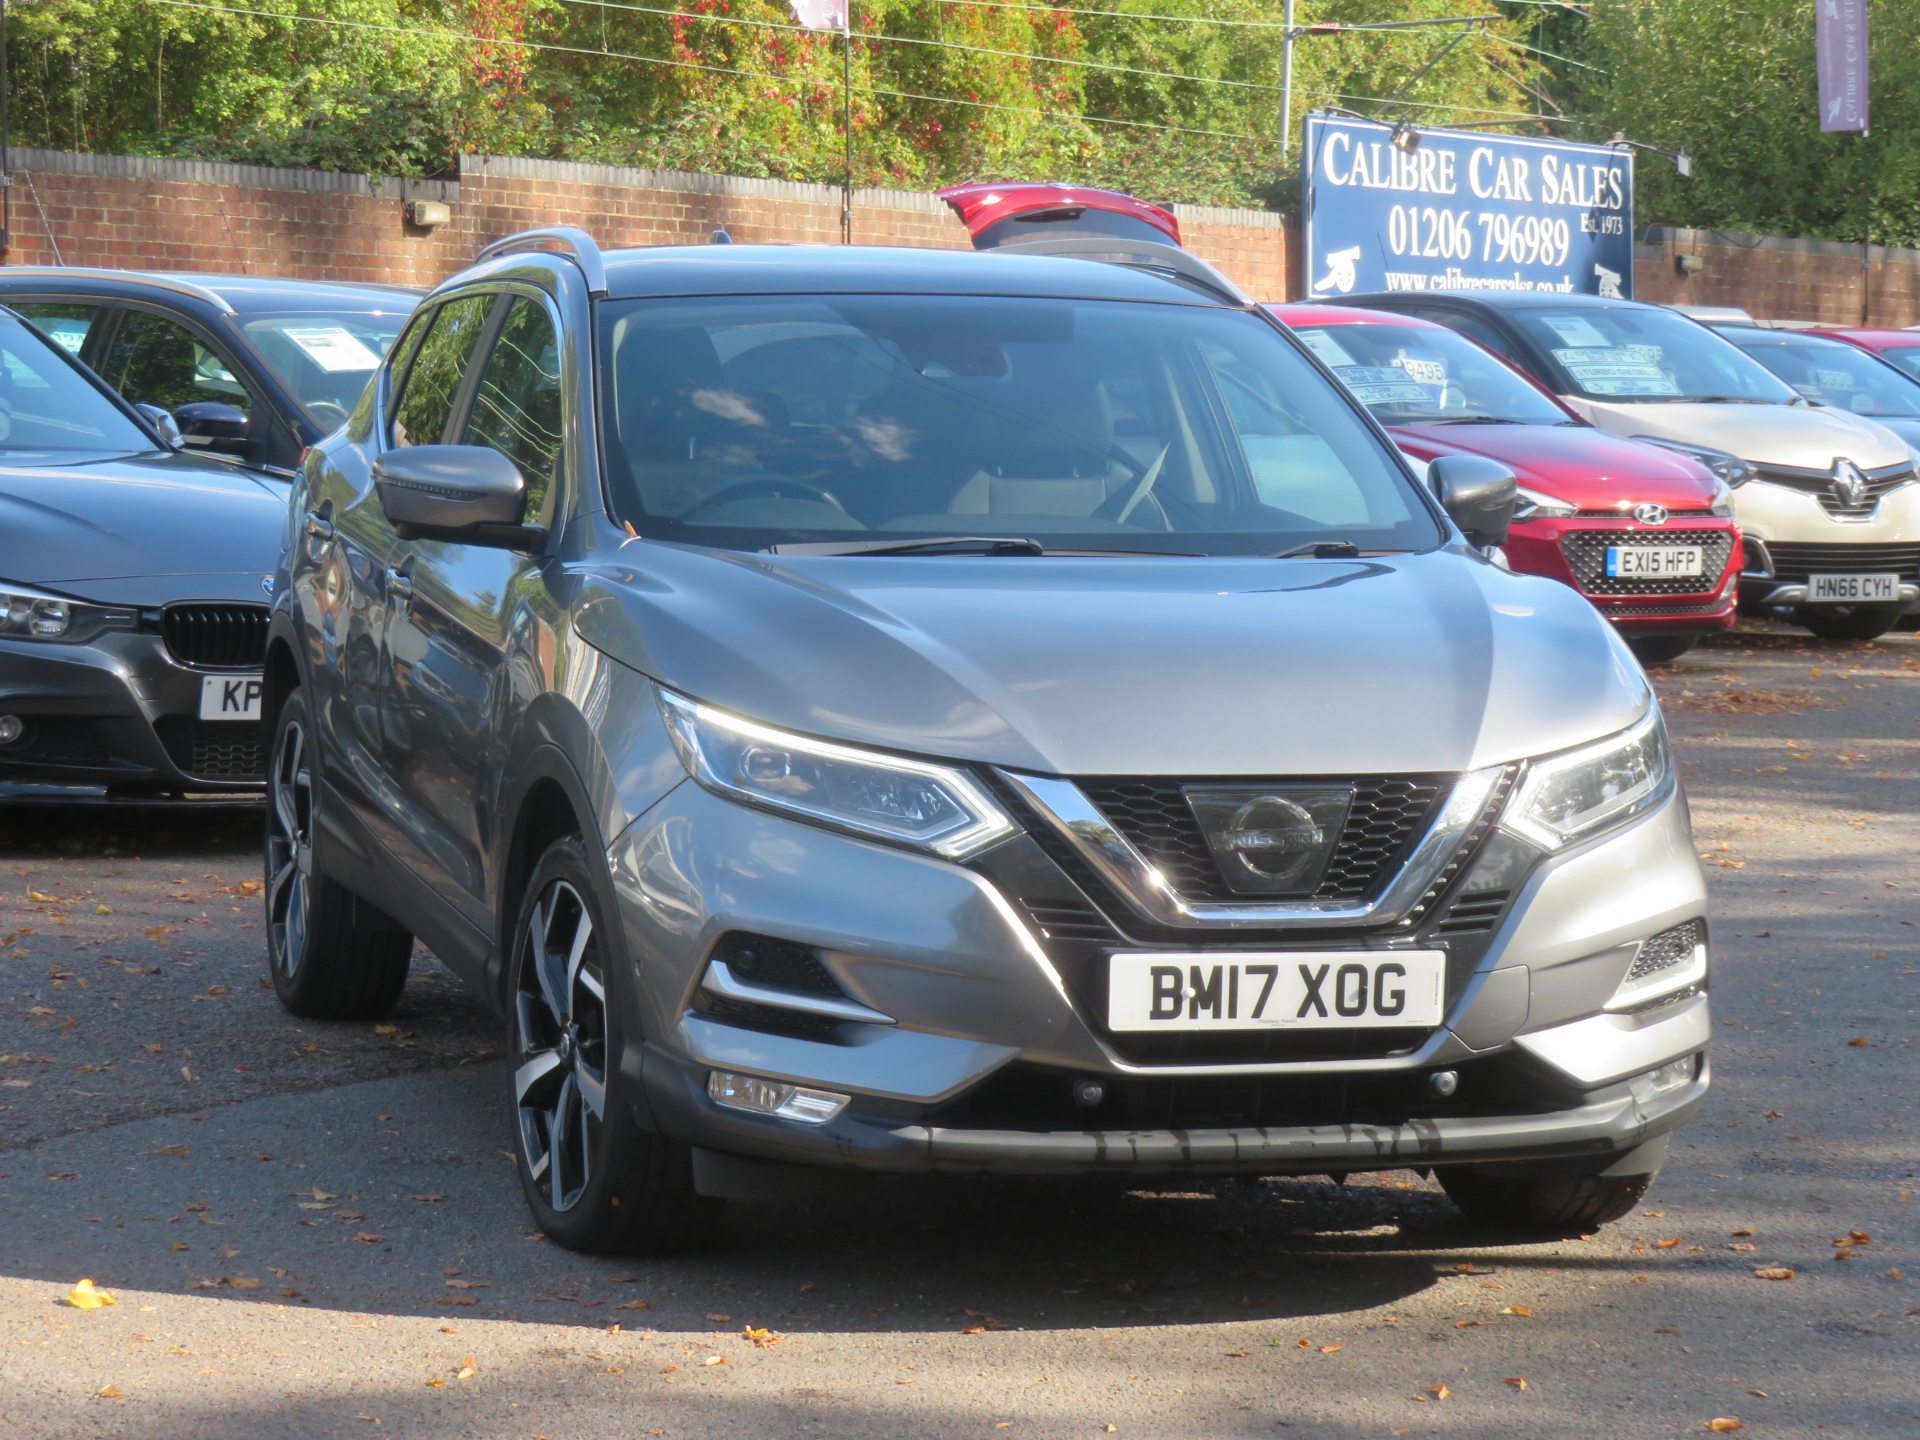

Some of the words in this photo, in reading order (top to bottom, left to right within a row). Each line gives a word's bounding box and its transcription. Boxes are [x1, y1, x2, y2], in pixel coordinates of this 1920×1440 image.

[1323, 132, 1457, 194] CALIBRE
[1470, 148, 1533, 202] CAR
[1541, 154, 1623, 210] SALES
[1601, 215, 1623, 235] 1973
[1389, 205, 1471, 260] 01206
[1478, 213, 1569, 267] 796989
[1385, 267, 1574, 293] wwwcalibrecarsalescouk
[1584, 368, 1616, 376] TURBO
[1360, 392, 1408, 401] MILEAGE
[1365, 386, 1392, 394] LOW
[1623, 552, 1660, 572] EX15
[1666, 551, 1695, 572] HFP
[1816, 578, 1858, 597] HN66
[1862, 578, 1892, 597] CYH
[1149, 964, 1279, 1020] BM17
[1296, 963, 1406, 1018] XOG
